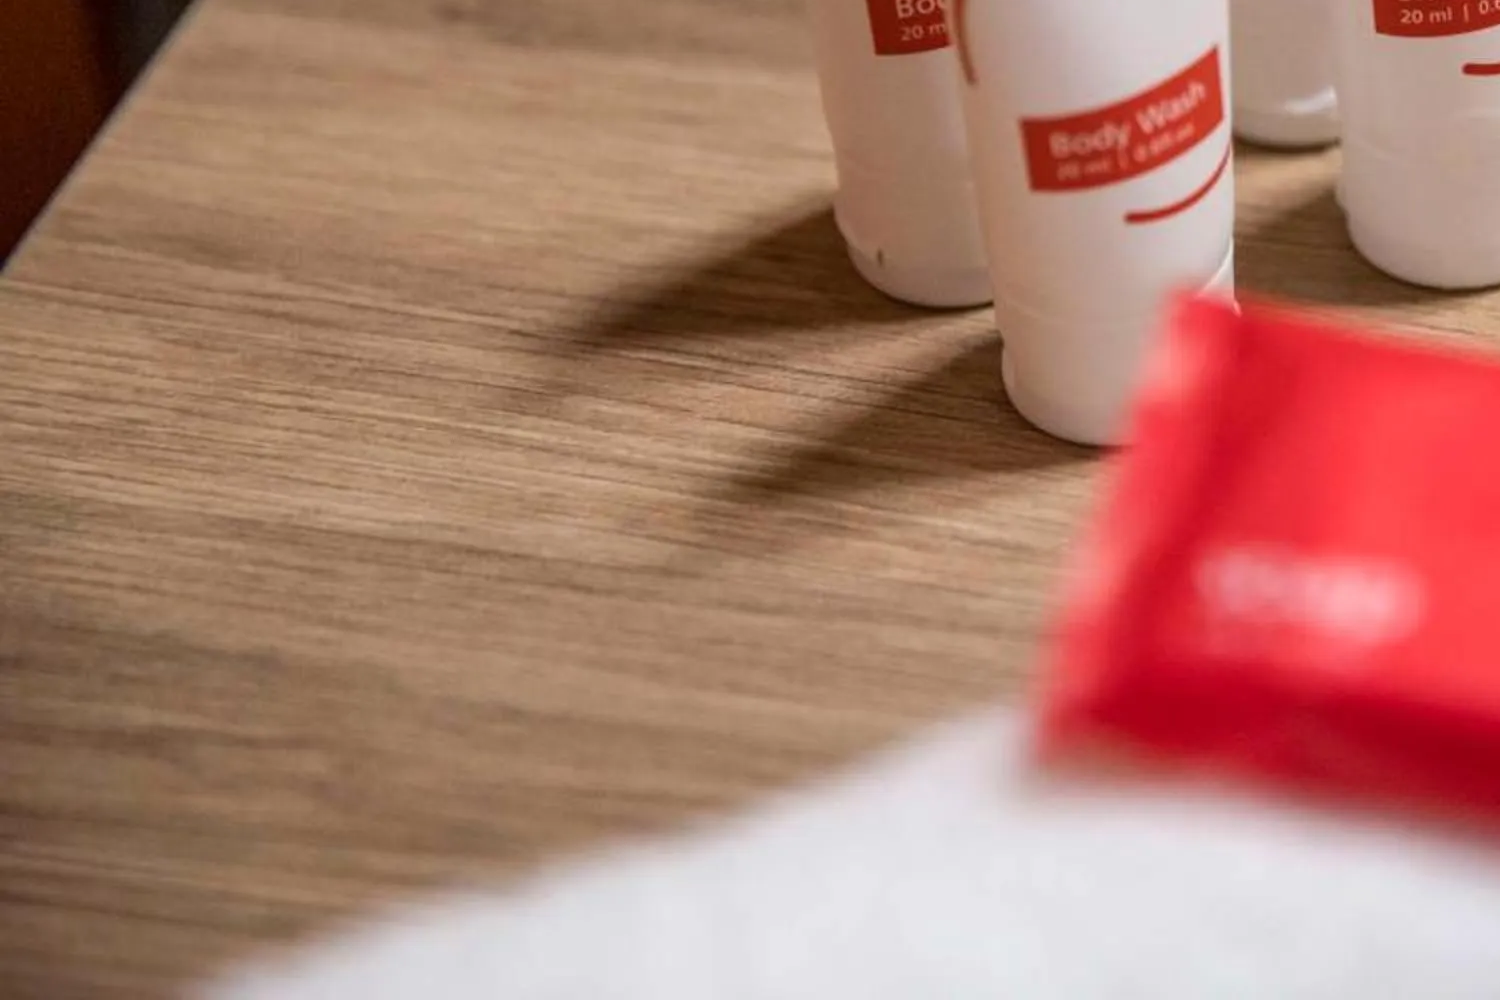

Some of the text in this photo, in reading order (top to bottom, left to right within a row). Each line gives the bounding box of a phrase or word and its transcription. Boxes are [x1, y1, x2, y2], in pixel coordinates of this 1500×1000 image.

[1400, 9, 1423, 24] 20
[1429, 7, 1452, 22] ml
[900, 25, 924, 41] 20
[1048, 120, 1131, 159] Body
[1134, 80, 1206, 135] Wash
